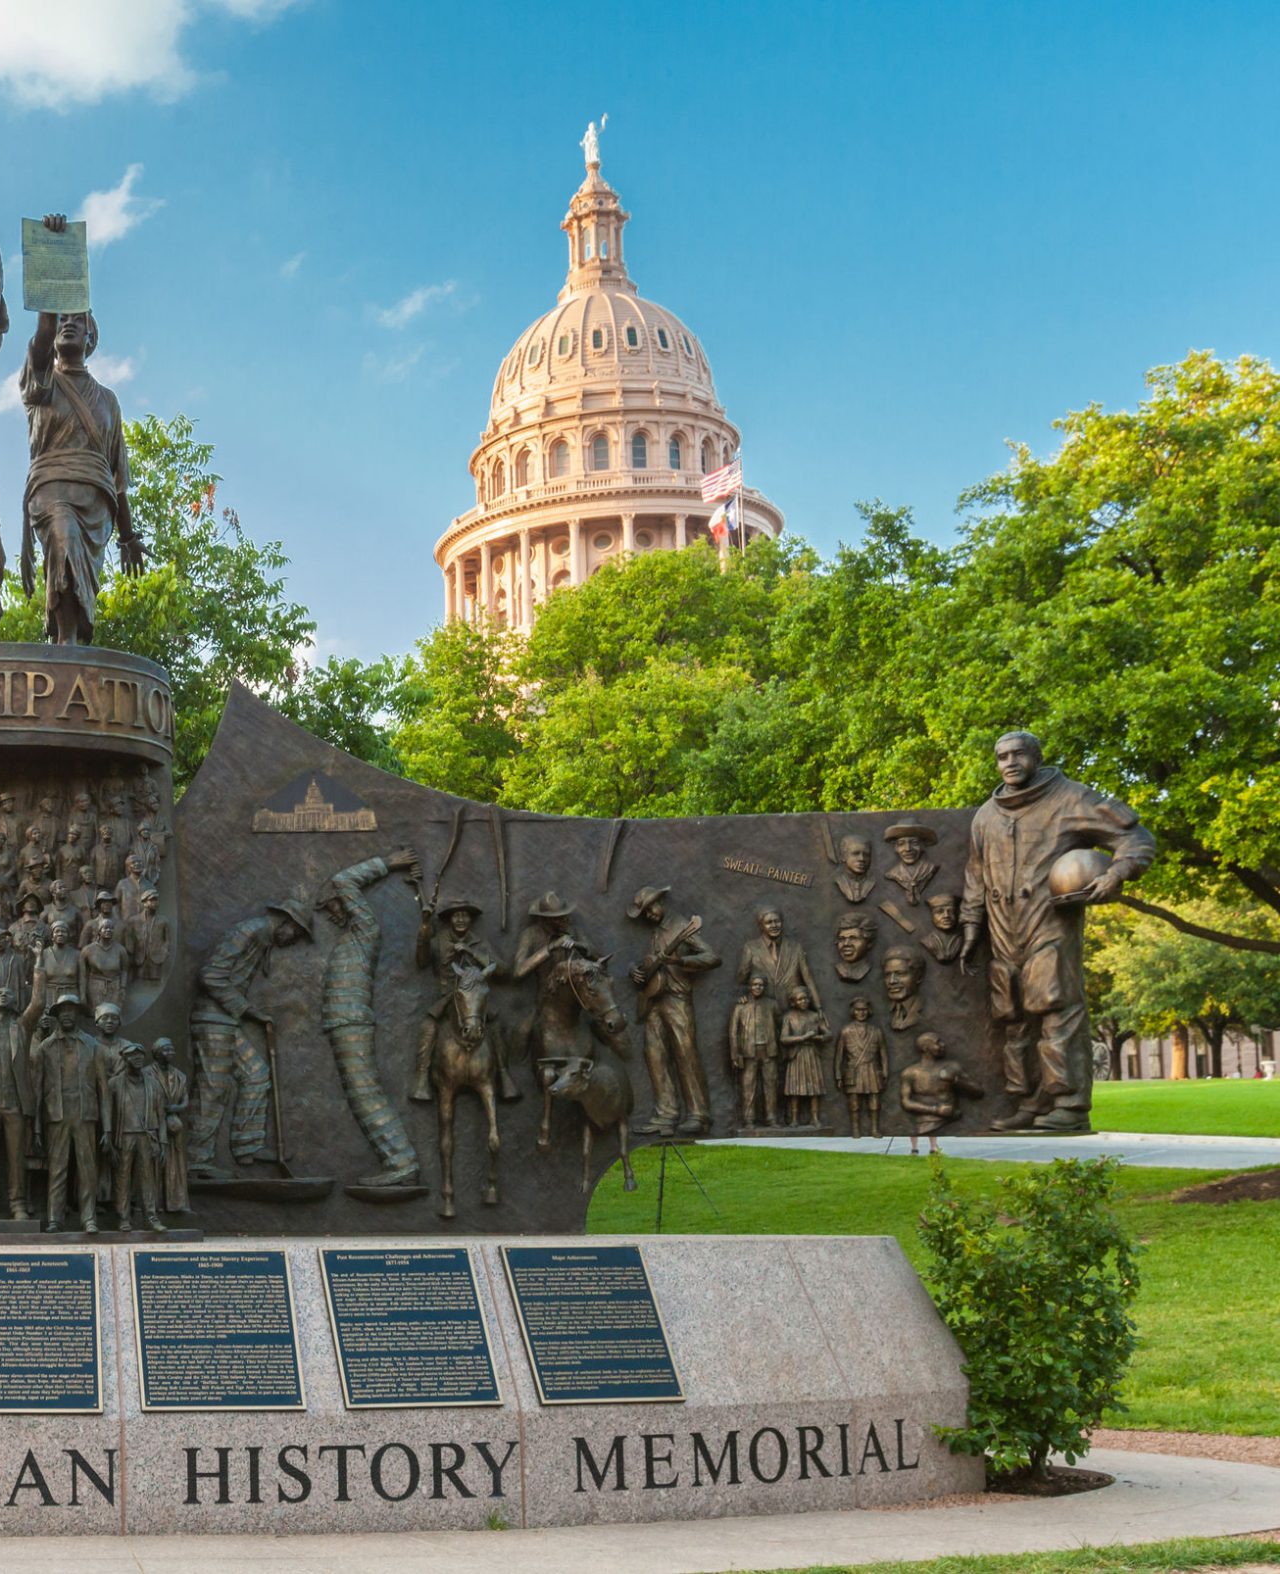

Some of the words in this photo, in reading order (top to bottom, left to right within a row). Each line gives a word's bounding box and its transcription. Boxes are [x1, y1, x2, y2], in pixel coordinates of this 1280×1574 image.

[767, 866, 808, 885] PAINTER
[183, 1441, 520, 1504] HISTORY
[572, 1419, 920, 1493] MEMORIAL
